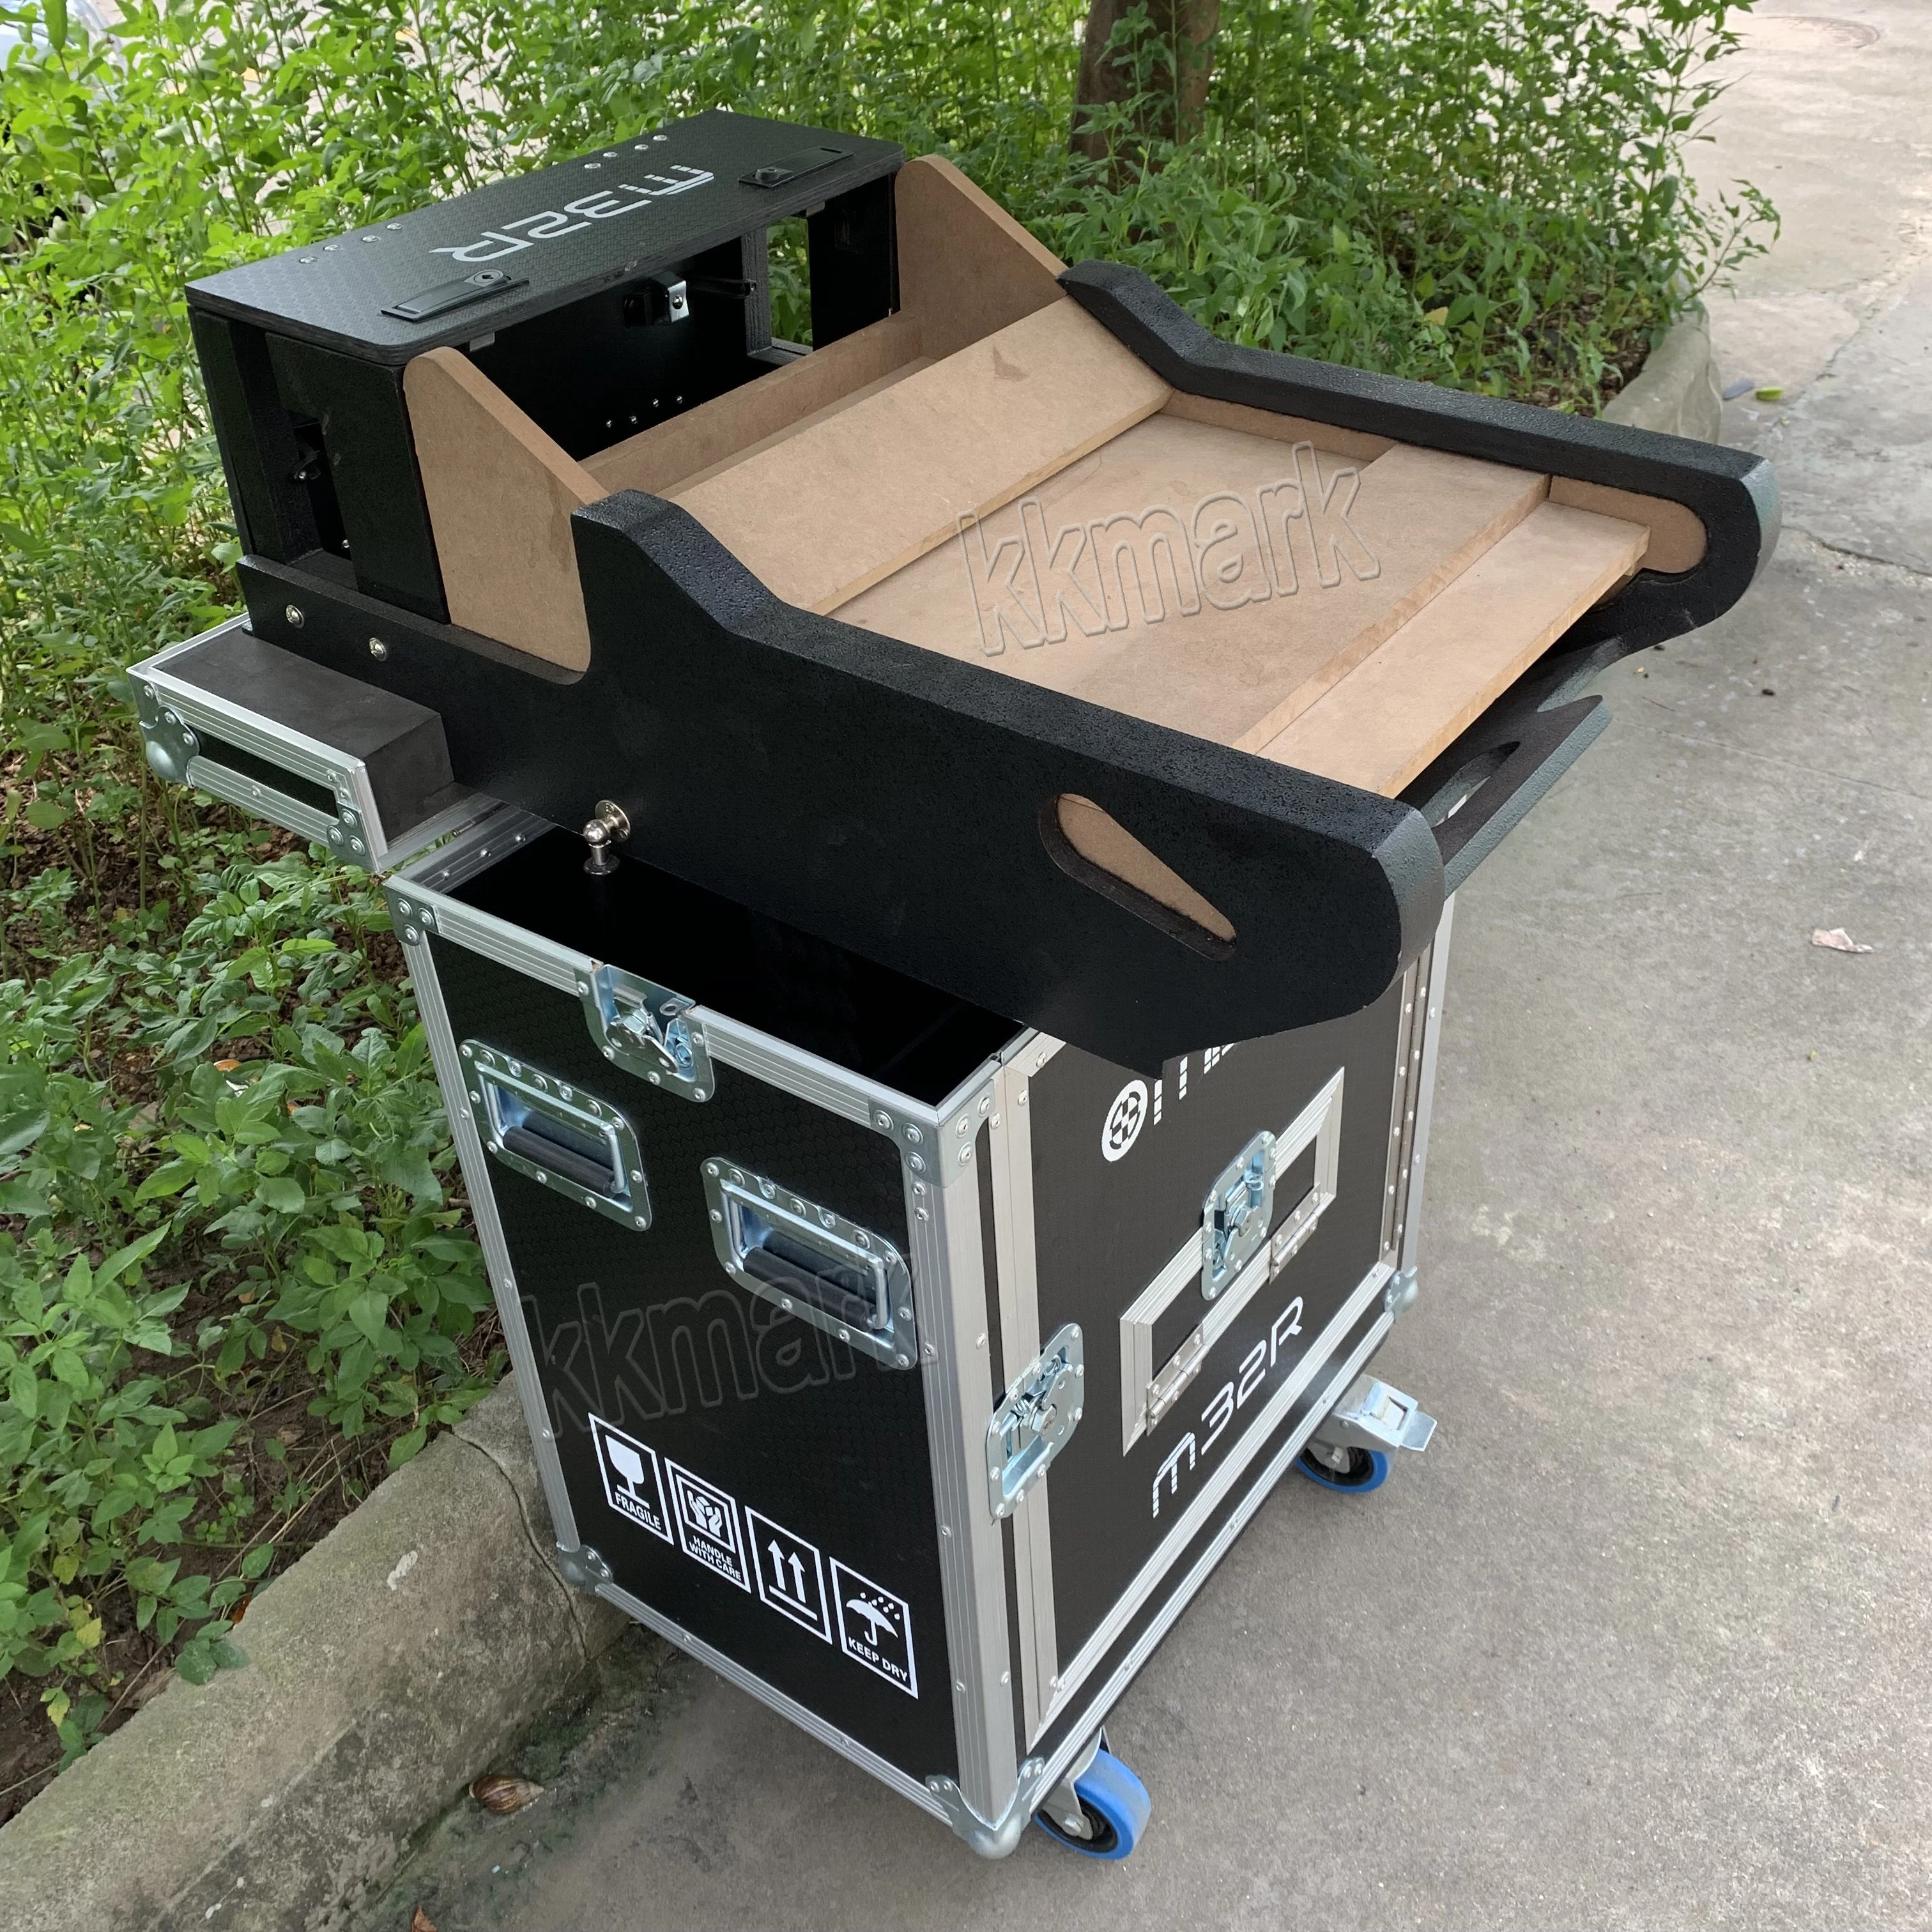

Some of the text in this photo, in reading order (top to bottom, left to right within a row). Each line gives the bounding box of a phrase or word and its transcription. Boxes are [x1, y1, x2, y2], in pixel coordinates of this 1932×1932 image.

[615, 1491, 662, 1531] FRAGILE
[688, 1541, 742, 1581] WITH CARE
[693, 1535, 733, 1567] HANDLE
[848, 1636, 908, 1682] KEEP DRY
